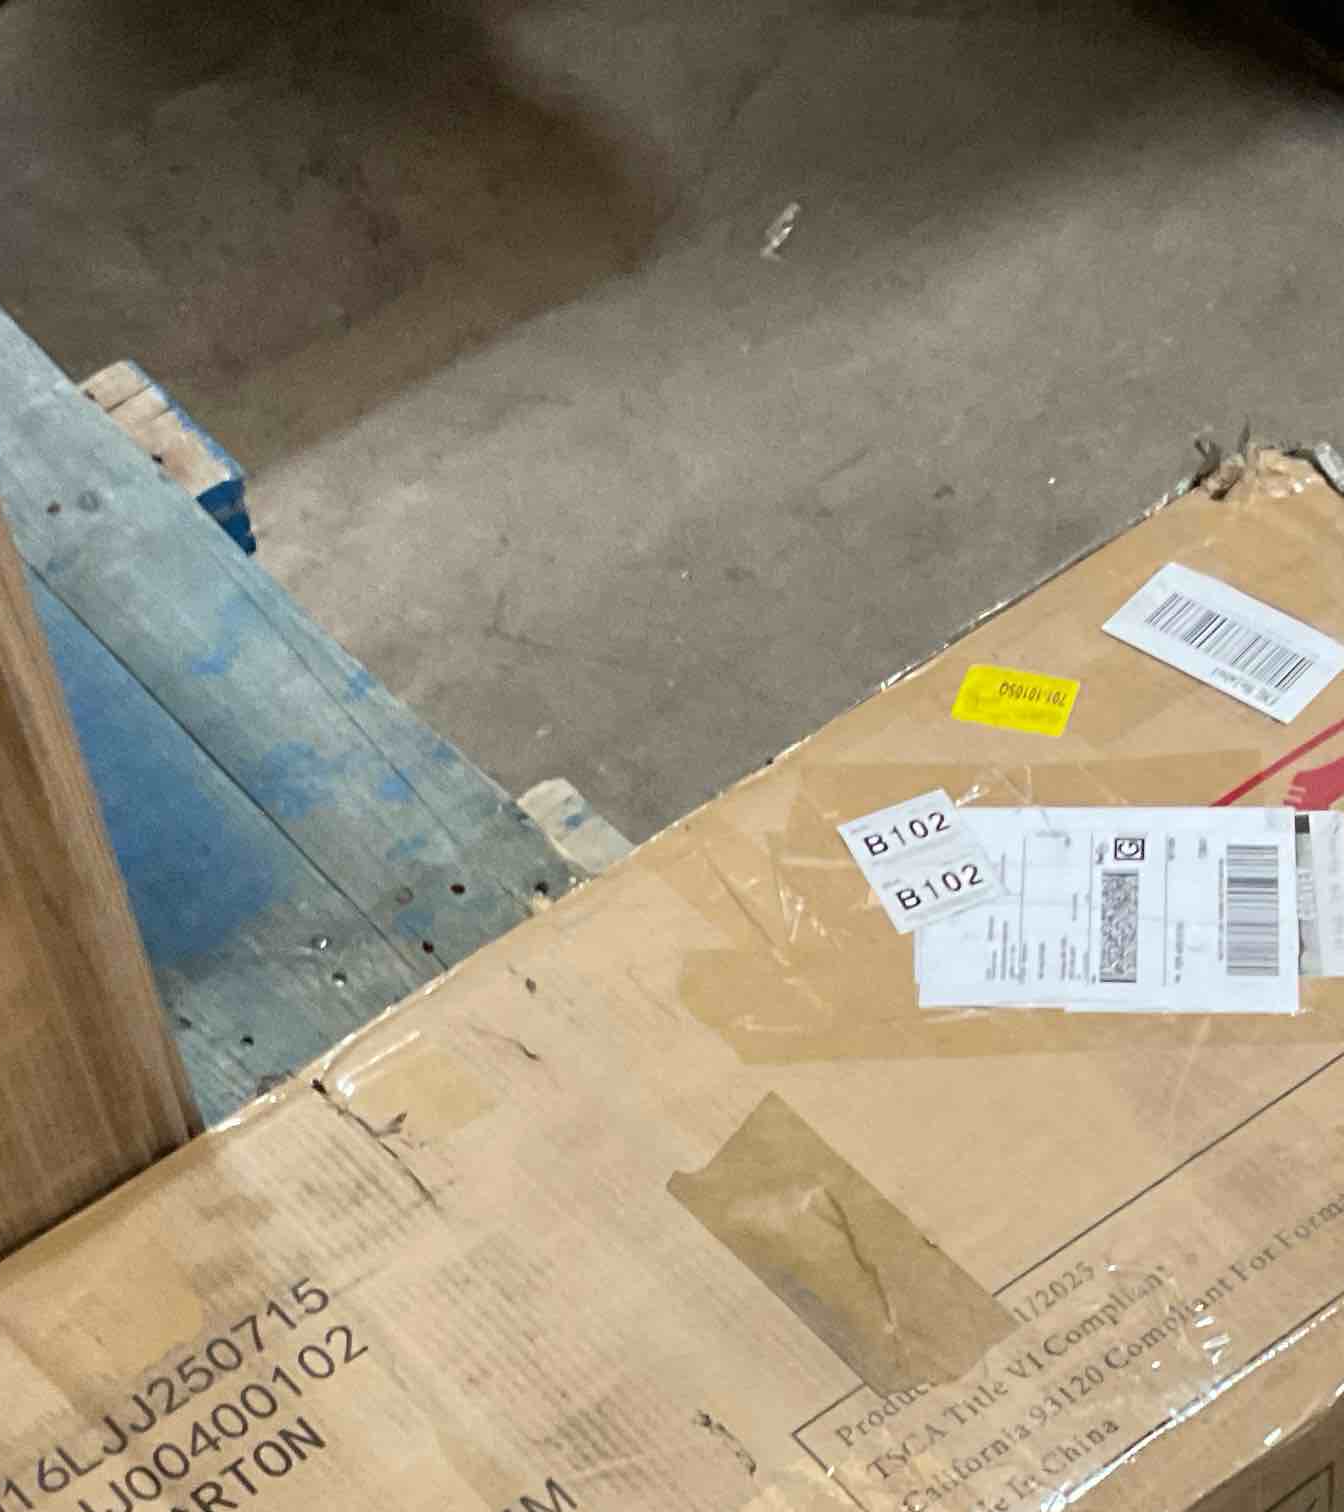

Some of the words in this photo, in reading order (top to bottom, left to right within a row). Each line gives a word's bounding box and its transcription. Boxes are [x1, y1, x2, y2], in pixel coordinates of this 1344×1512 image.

[862, 811, 952, 857] B102
[895, 862, 984, 911] B102
[1030, 1364, 1105, 1426] 93120
[1229, 1244, 1278, 1284] For
[943, 1379, 1009, 1426] Title
[1041, 1419, 1120, 1477] China
